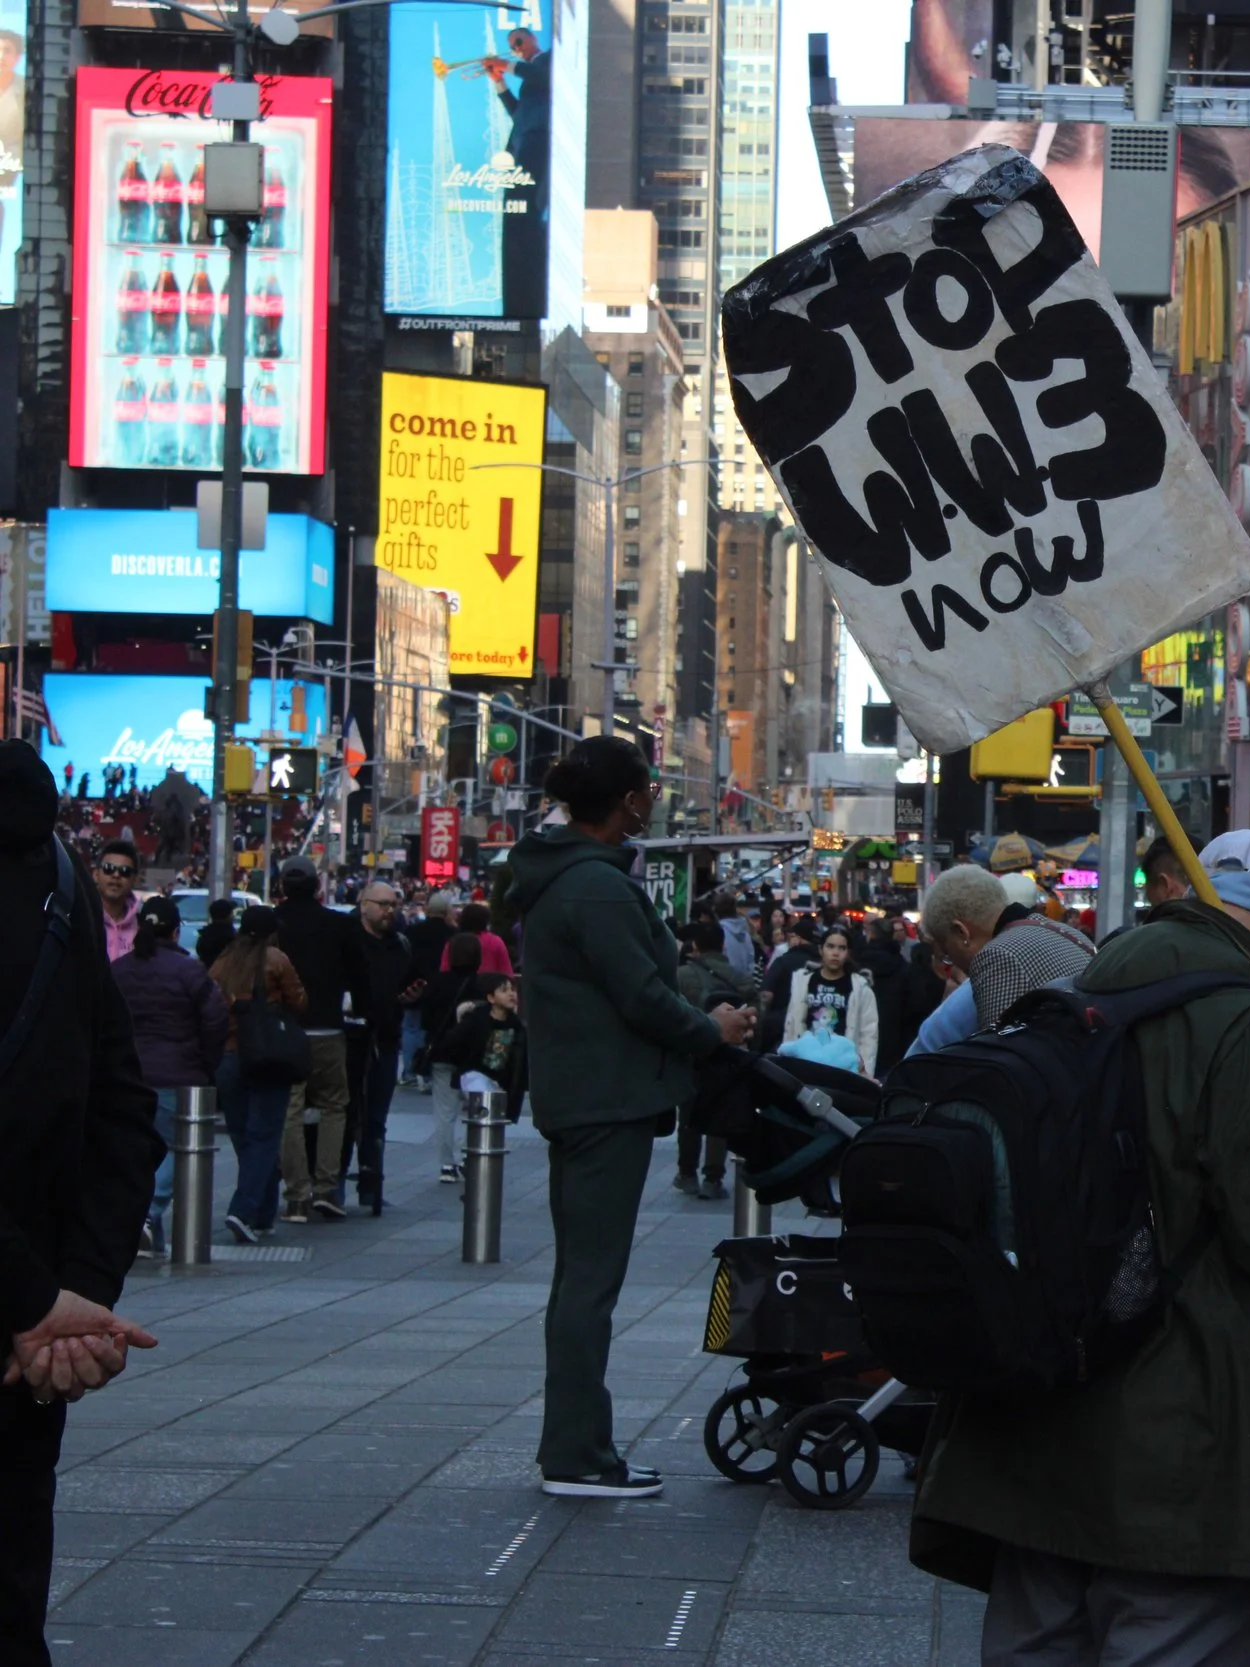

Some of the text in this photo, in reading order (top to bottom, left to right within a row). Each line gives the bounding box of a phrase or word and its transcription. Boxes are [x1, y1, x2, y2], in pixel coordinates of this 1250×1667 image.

[389, 411, 518, 445] come in
[387, 438, 465, 483] for the
[384, 490, 470, 534] perfect
[111, 554, 242, 577] DISCOVERLA.C
[383, 531, 438, 572] gifts
[451, 651, 515, 667] ore today
[430, 811, 454, 858] tkts
